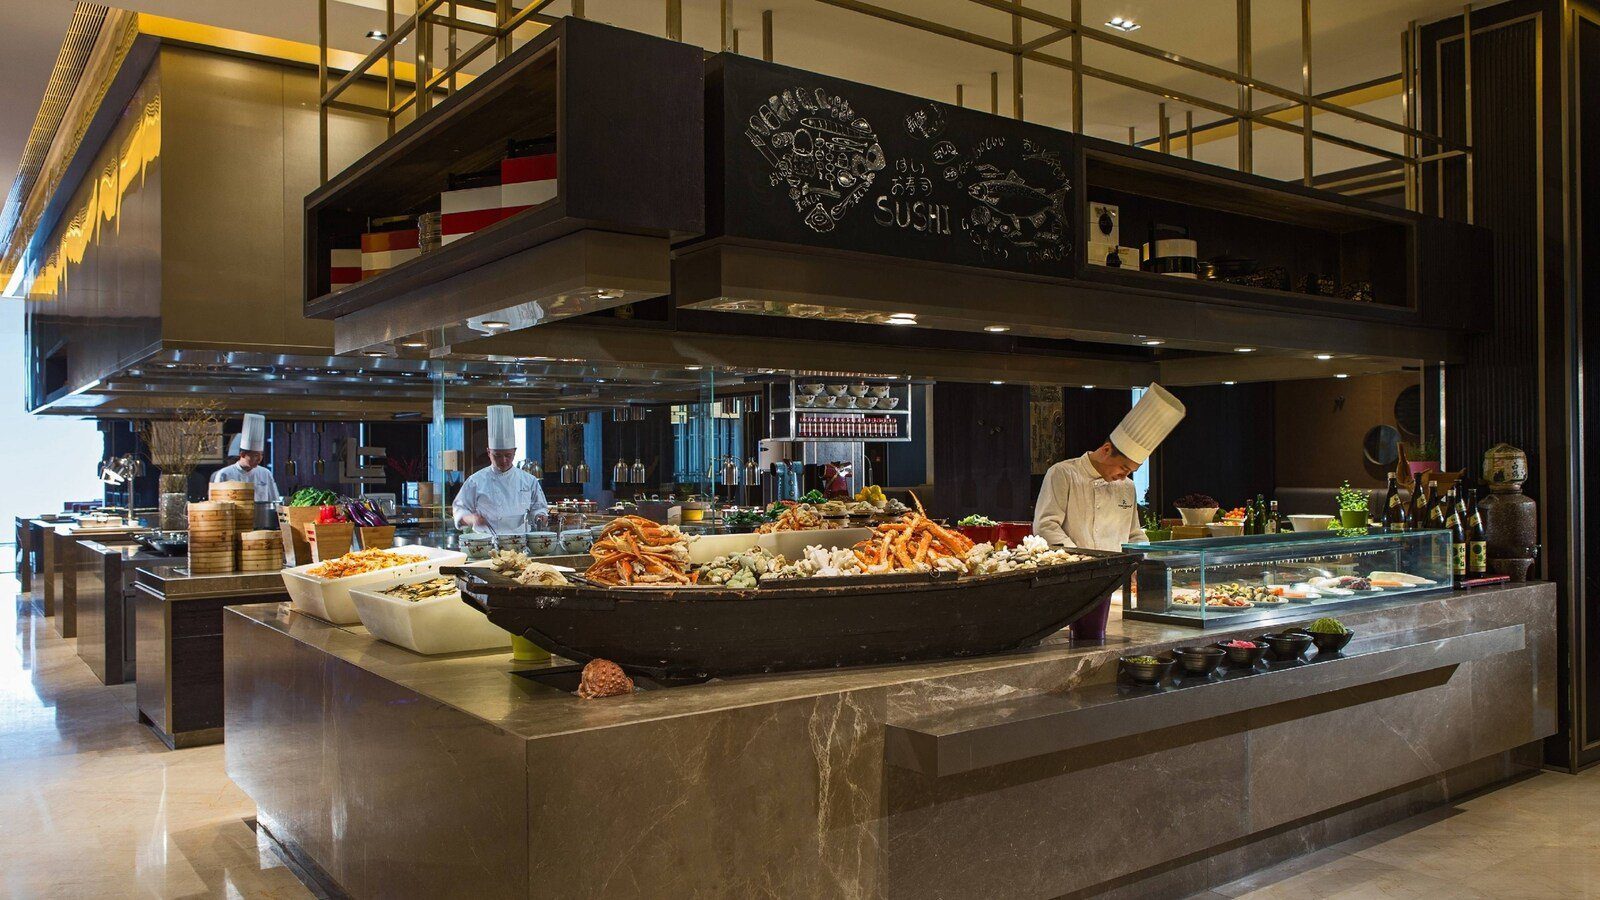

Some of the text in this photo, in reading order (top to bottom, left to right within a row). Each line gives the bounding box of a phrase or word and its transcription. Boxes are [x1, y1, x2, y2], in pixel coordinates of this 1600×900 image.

[891, 174, 933, 197] お寿司
[873, 195, 953, 235] SUSHI
